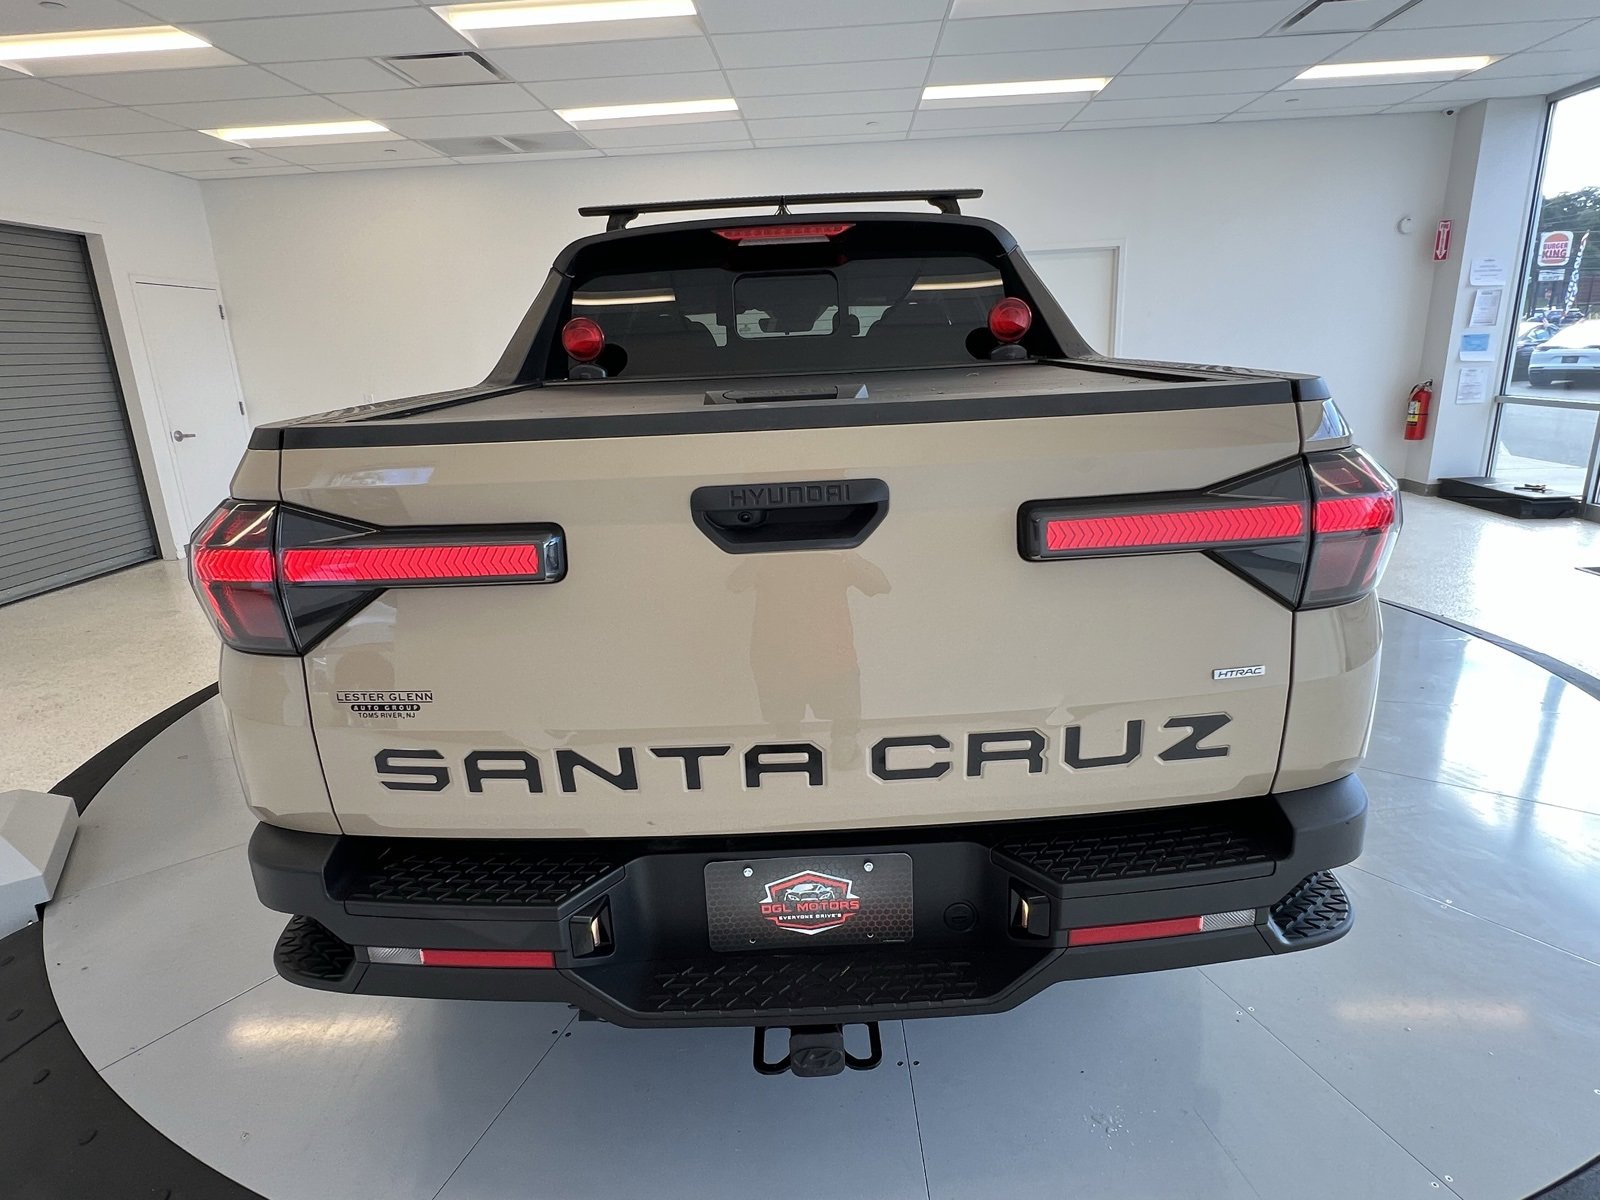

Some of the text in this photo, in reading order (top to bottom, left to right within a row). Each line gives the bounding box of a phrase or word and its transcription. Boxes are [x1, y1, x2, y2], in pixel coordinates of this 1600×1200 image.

[1543, 242, 1569, 250] BURGER
[1542, 249, 1568, 259] KING
[731, 484, 850, 506] HYUNDAI
[1217, 667, 1263, 678] HTRAC
[336, 692, 433, 702] LESTER GLENN
[380, 711, 405, 720] RIVER,
[406, 711, 416, 719] NJ
[374, 712, 1233, 794] SANTA CRUZ
[761, 900, 860, 914] DGL MOTORS
